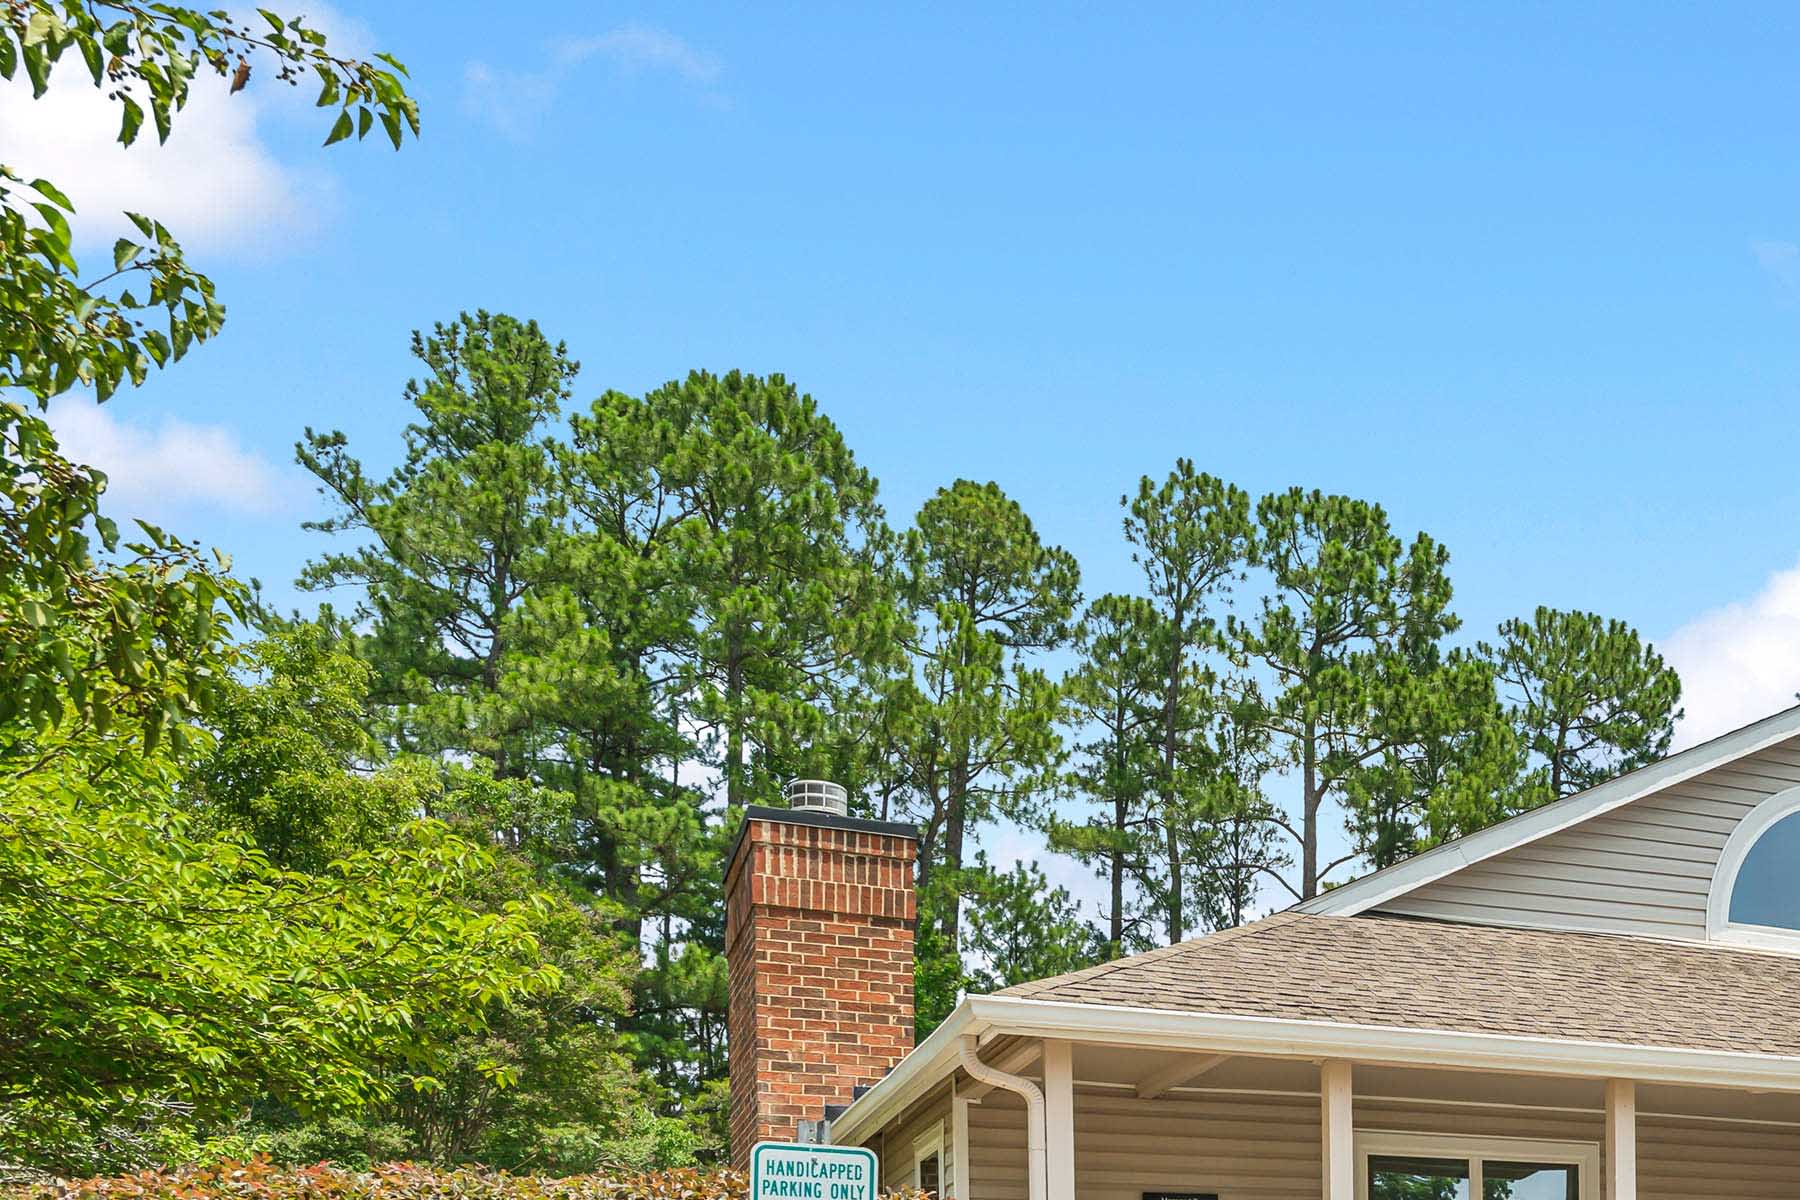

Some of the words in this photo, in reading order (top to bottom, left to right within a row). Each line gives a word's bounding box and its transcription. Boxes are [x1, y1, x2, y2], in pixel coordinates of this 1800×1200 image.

[766, 1160, 862, 1181] HANDICAPPED
[762, 1179, 822, 1198] PARKING
[830, 1183, 865, 1200] ONLY
